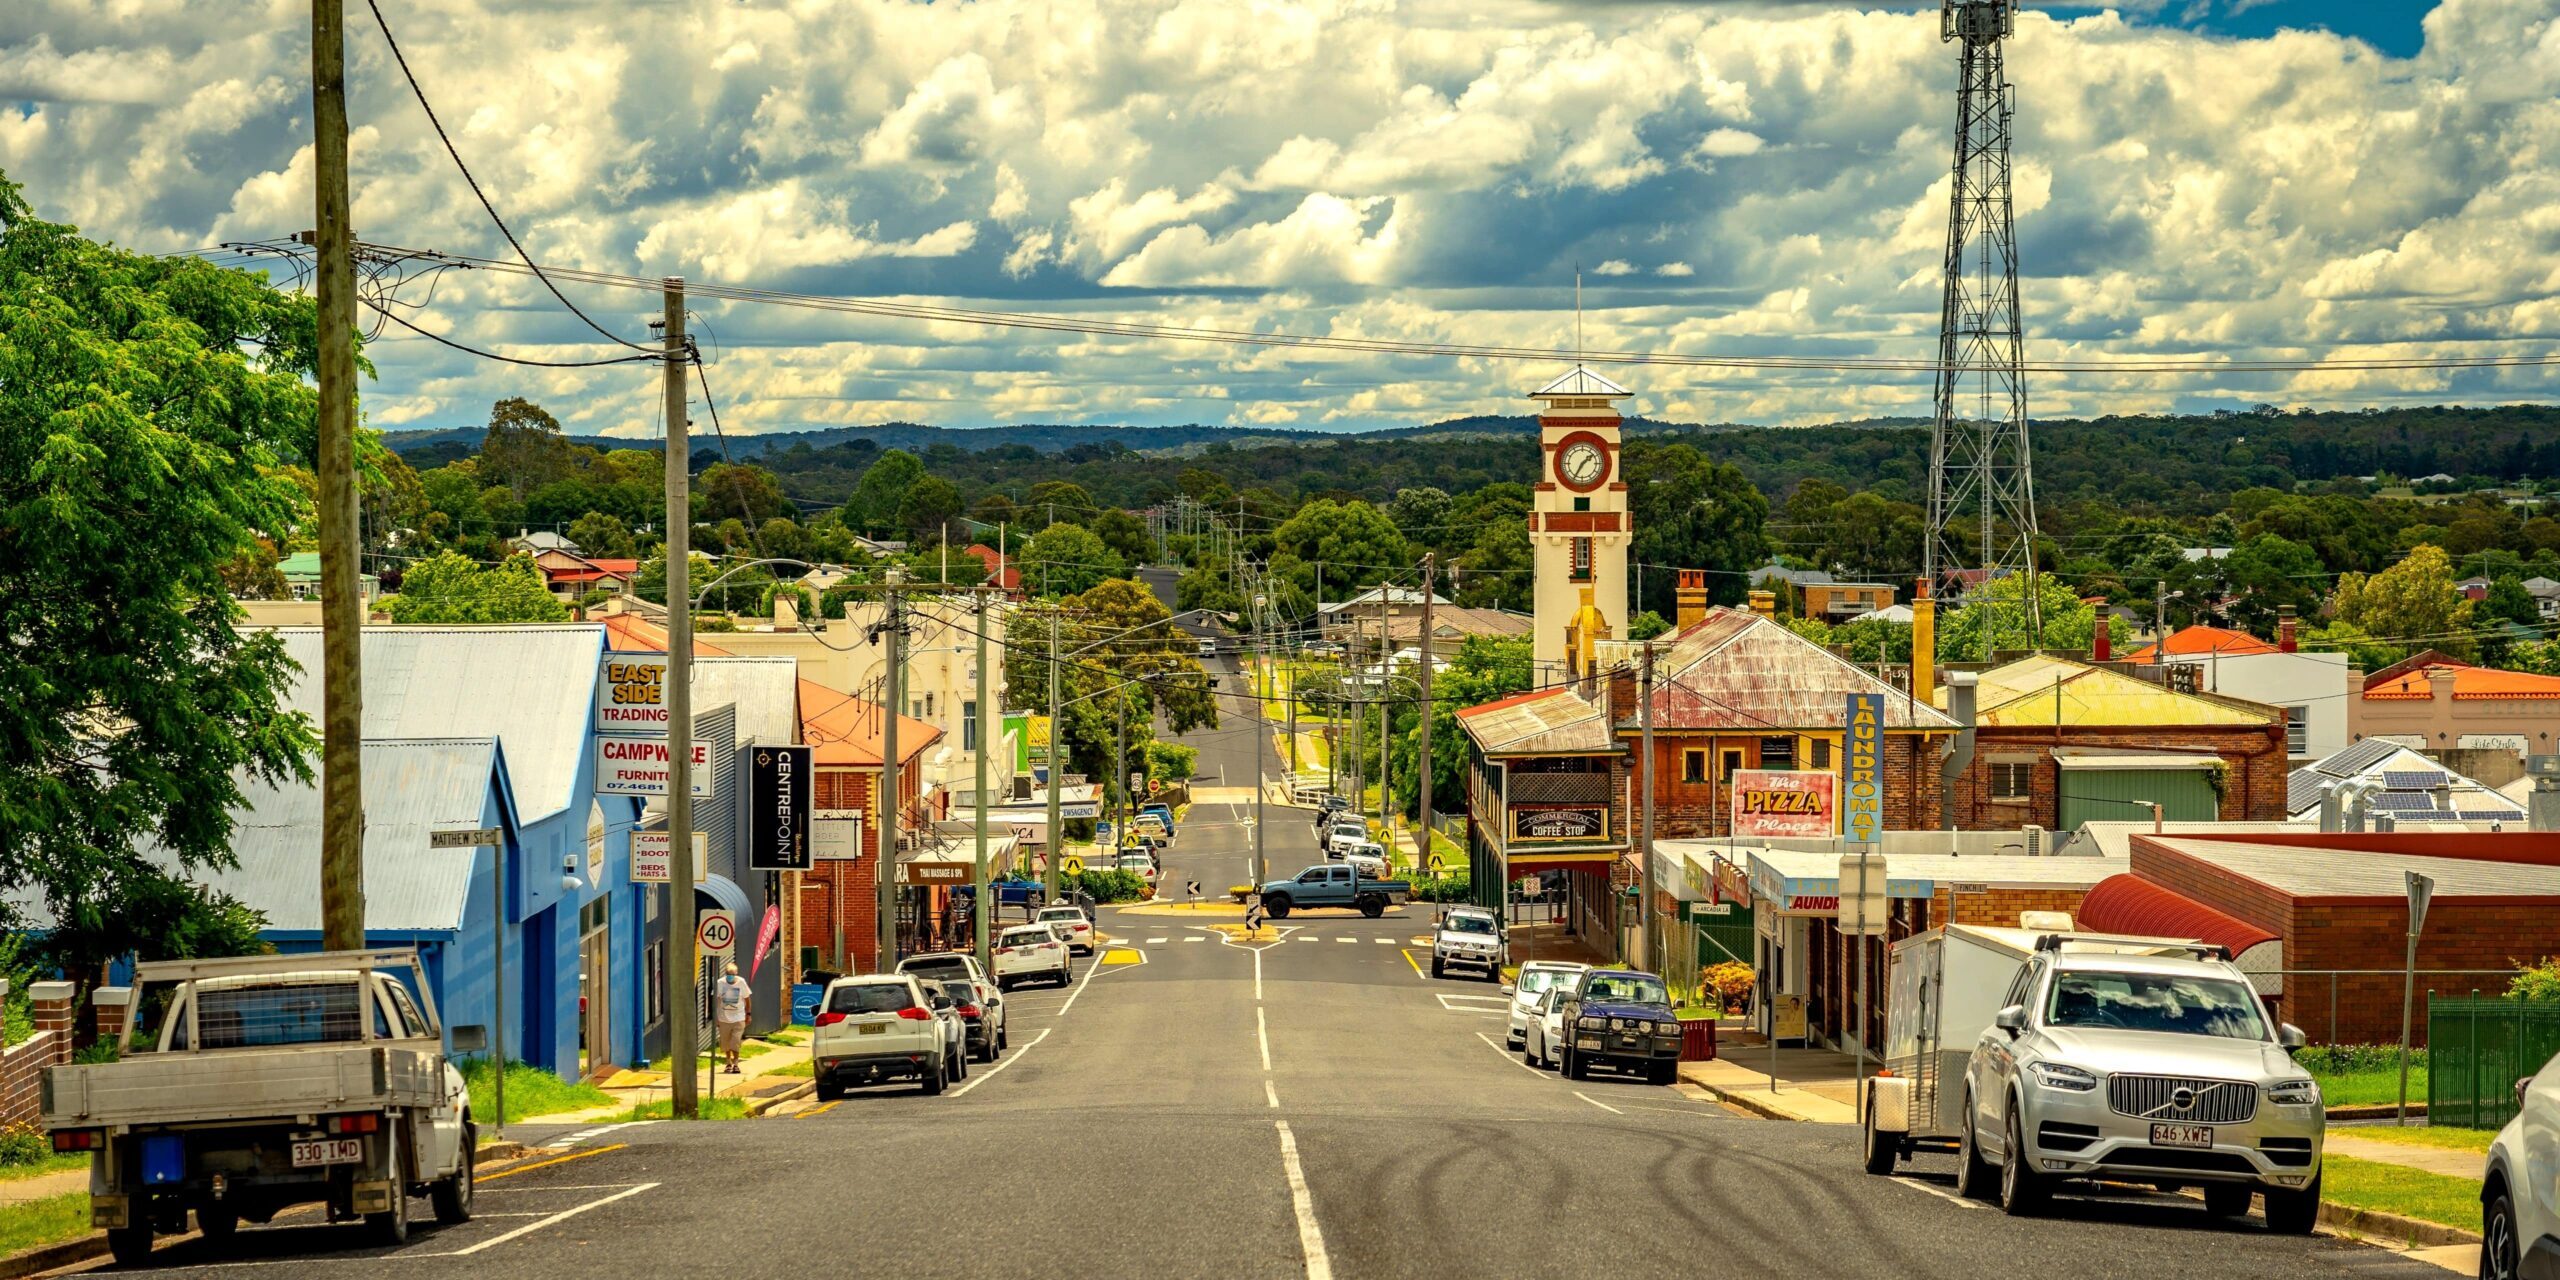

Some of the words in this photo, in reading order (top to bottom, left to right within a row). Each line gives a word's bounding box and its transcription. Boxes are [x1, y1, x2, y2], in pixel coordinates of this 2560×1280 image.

[608, 664, 667, 684] EAST
[612, 685, 662, 704] SIDE
[602, 708, 668, 722] TRADING
[604, 742, 706, 764] CAMPWE
[1851, 697, 1878, 841] LAUNDROMAT
[1769, 776, 1800, 788] The
[777, 751, 792, 865] CENTREPOINT
[1743, 790, 1824, 815] PIZZA
[1061, 807, 1093, 816] EWSAGENCY
[1528, 812, 1590, 825] COMMERCIAL
[1532, 826, 1561, 836] COFFEE
[1565, 826, 1586, 836] STOP
[1753, 818, 1812, 831] Place
[431, 832, 470, 846] MATTHEW
[473, 832, 483, 844] ST
[1793, 896, 1839, 909] AUNDR
[704, 925, 729, 941] 40
